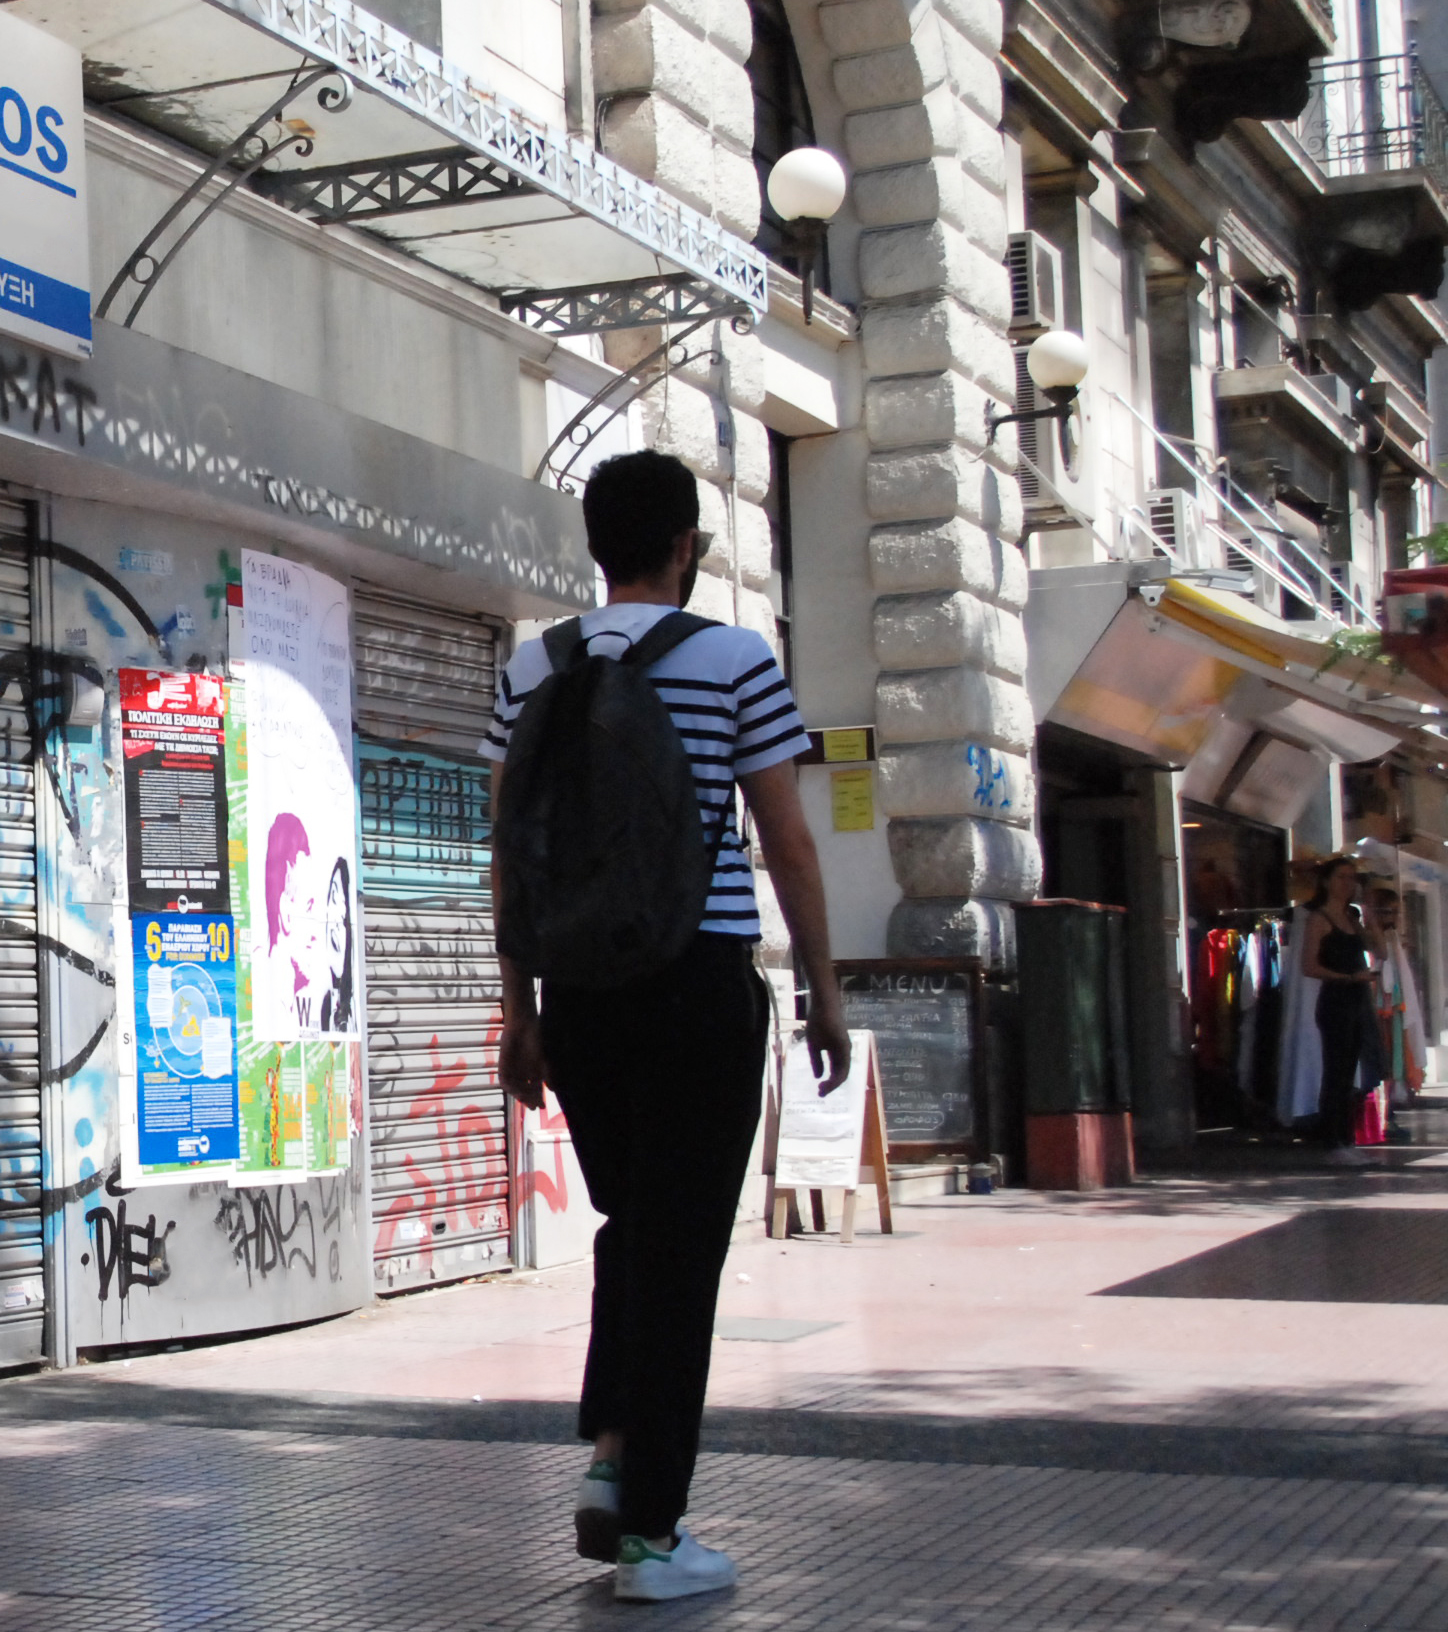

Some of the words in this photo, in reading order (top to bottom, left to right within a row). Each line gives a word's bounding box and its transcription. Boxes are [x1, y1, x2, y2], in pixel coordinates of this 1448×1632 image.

[128, 710, 172, 725] ΠΟΛΙΤΙΚΗ
[174, 714, 219, 728] ΕΚΔΗΛΩΣΗ
[147, 921, 161, 962] 6
[208, 922, 230, 963] 10
[869, 973, 949, 995] MENU
